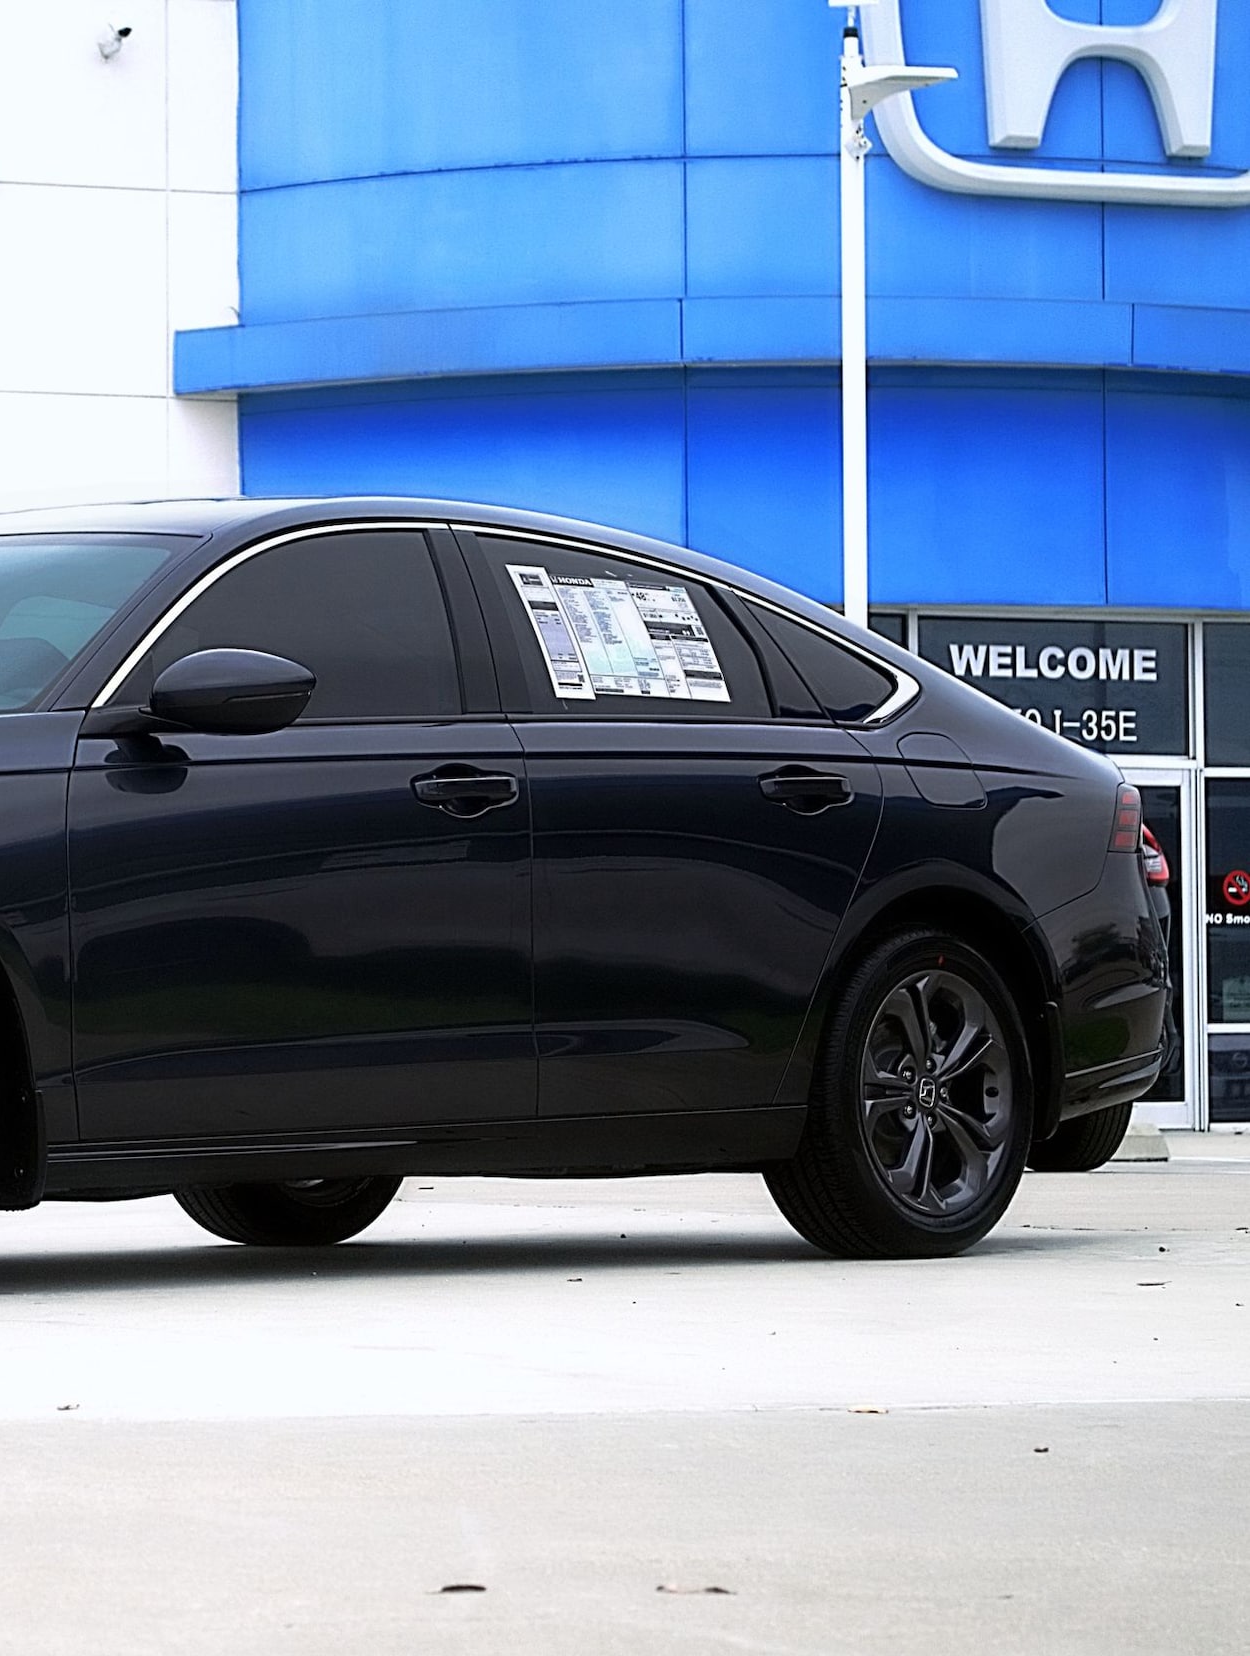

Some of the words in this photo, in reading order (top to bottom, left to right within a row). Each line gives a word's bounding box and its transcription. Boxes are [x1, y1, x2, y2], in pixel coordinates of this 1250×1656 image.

[950, 644, 1157, 681] WELCOME
[1053, 709, 1137, 741] I-35E
[1205, 913, 1223, 924] NO
